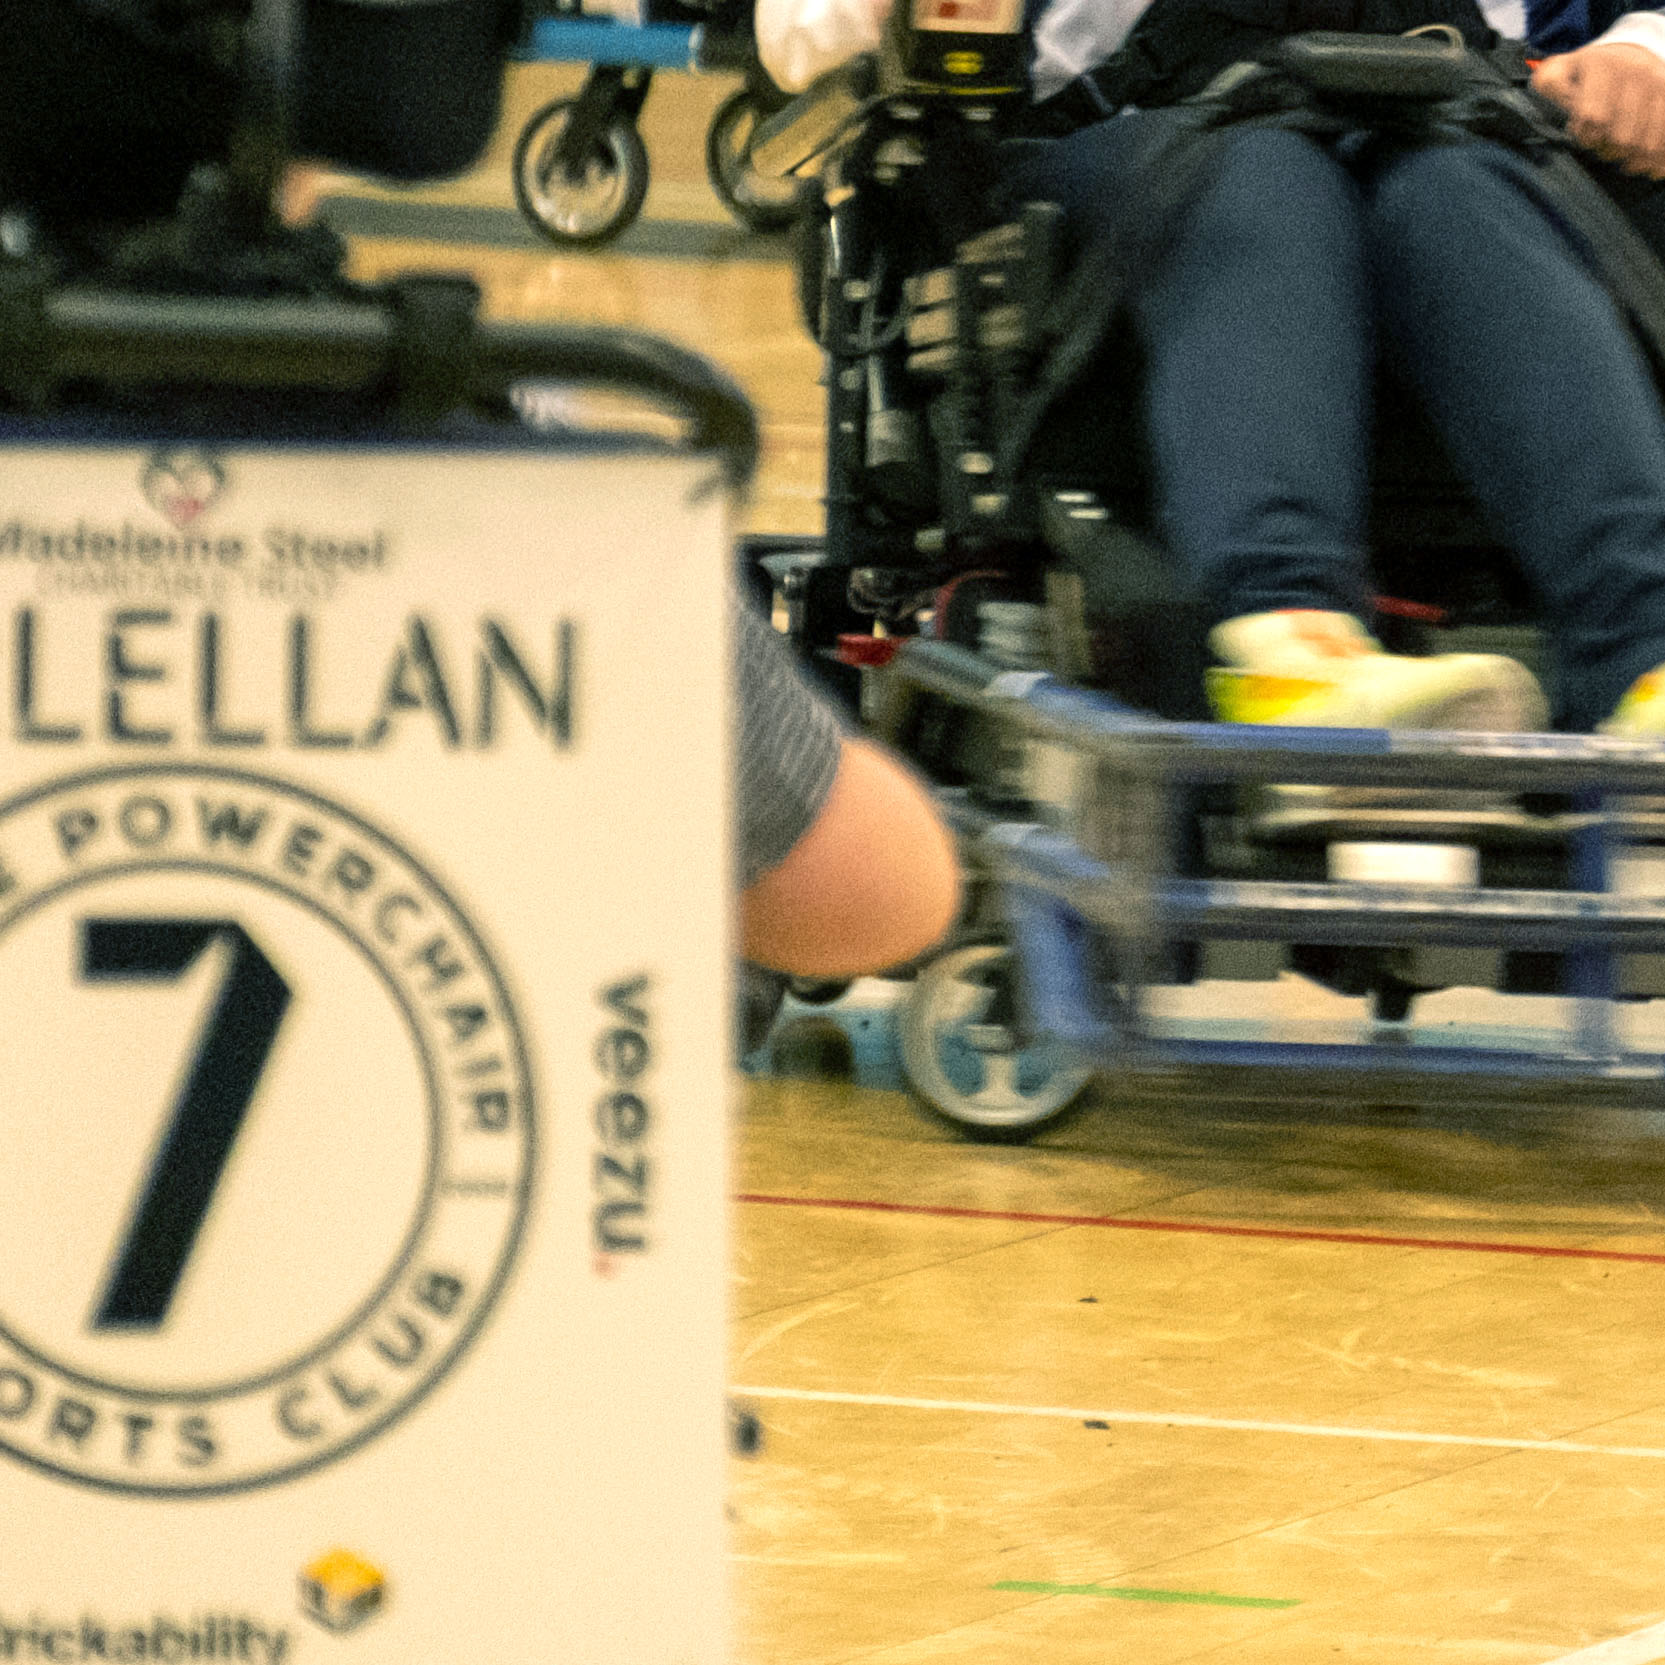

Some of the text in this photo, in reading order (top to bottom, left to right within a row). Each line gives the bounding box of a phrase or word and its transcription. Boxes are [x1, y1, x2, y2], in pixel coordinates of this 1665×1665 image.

[14, 606, 576, 750] LELLAN
[54, 792, 514, 1138] POWERCHAIR
[76, 914, 294, 1334] 7
[592, 970, 652, 1254] veezu
[273, 1266, 466, 1442] CLUB
